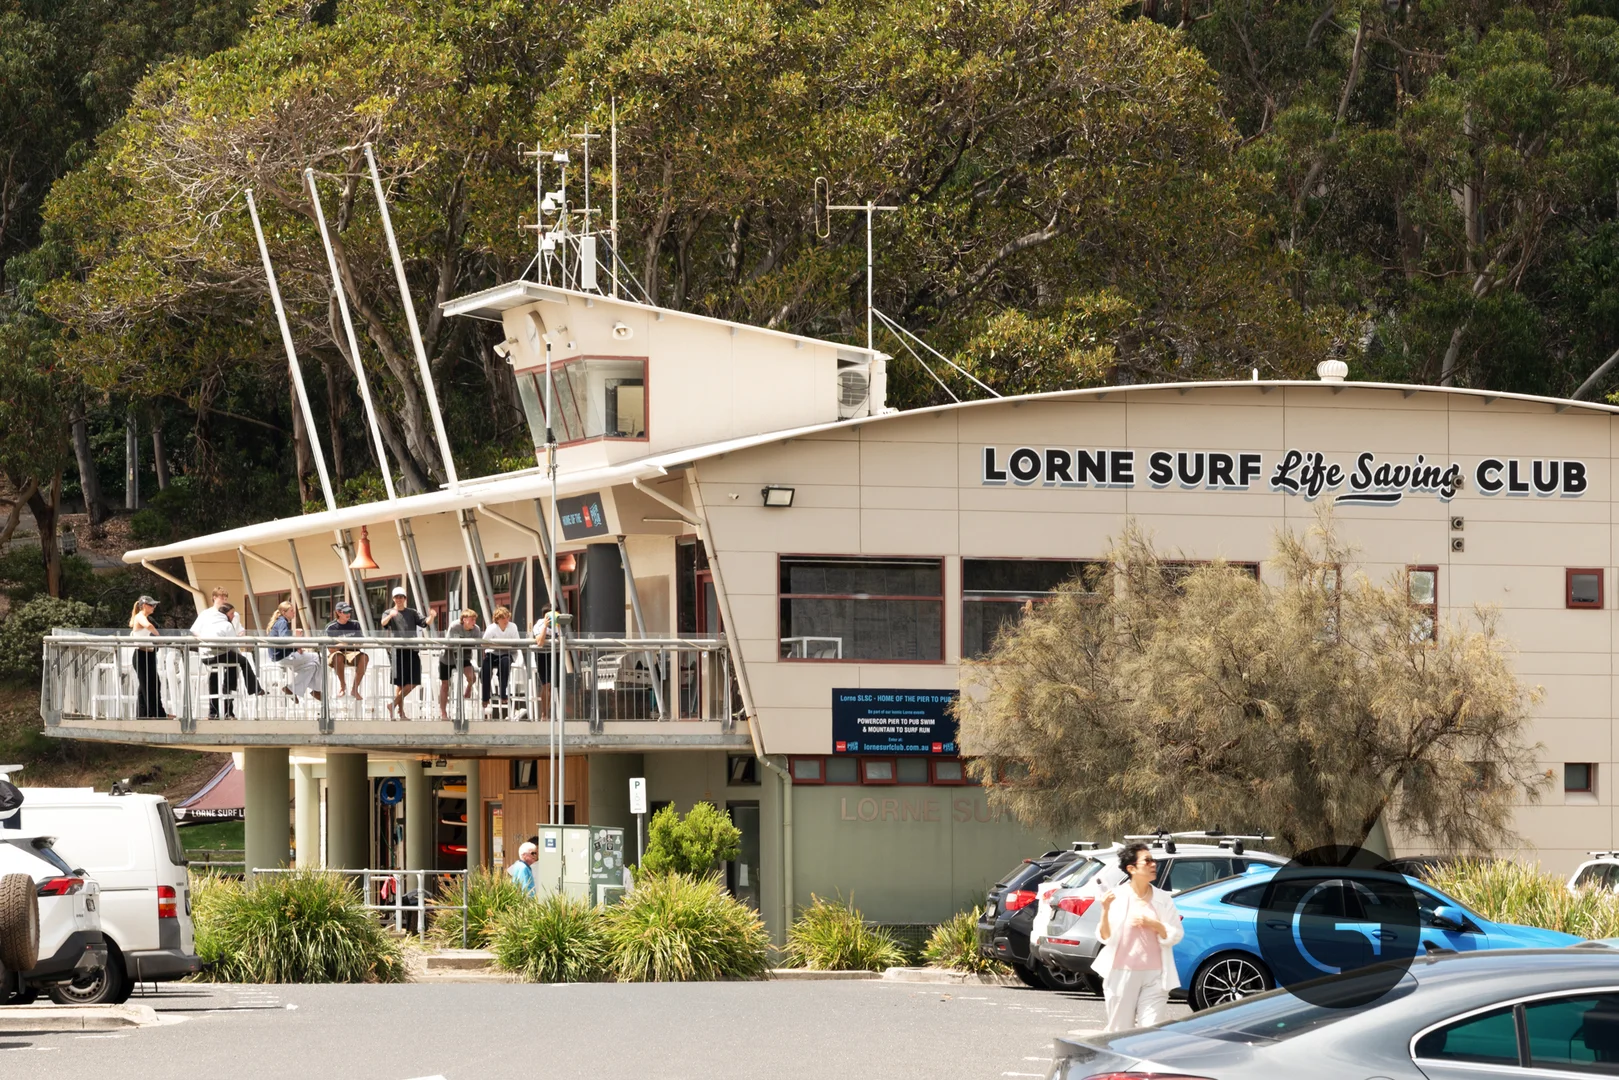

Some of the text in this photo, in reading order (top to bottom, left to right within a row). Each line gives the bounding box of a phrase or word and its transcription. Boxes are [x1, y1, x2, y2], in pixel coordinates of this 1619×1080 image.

[983, 446, 1588, 503] LORNE SURF Life Saving CLUB
[635, 781, 640, 789] P
[218, 809, 237, 817] SURF
[840, 798, 940, 822] LORNE
